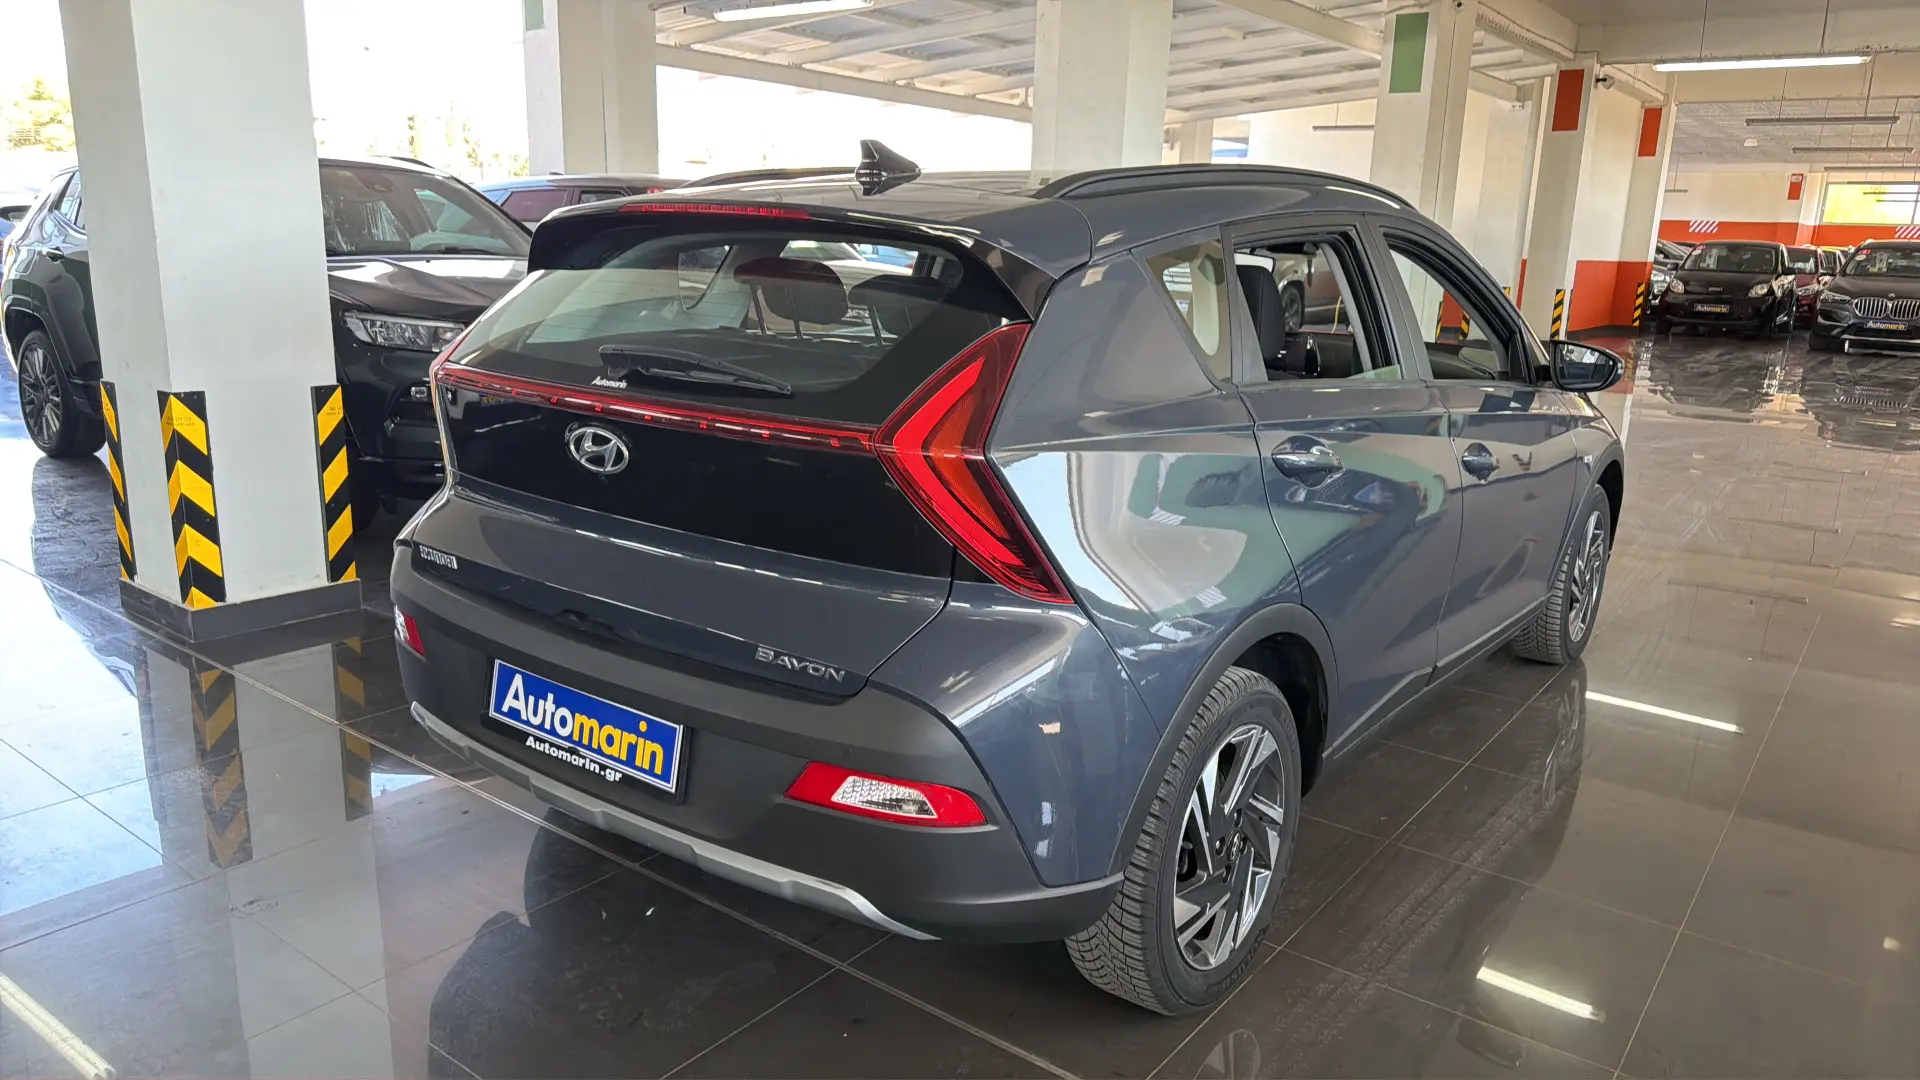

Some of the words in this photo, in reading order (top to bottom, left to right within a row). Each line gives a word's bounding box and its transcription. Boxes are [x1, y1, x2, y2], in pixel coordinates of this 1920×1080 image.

[1866, 320, 1906, 331] Automarin
[591, 375, 628, 389] Automarin
[755, 647, 846, 683] BAYON
[501, 672, 664, 776] Automarin
[525, 735, 623, 783] Automarin.gr
